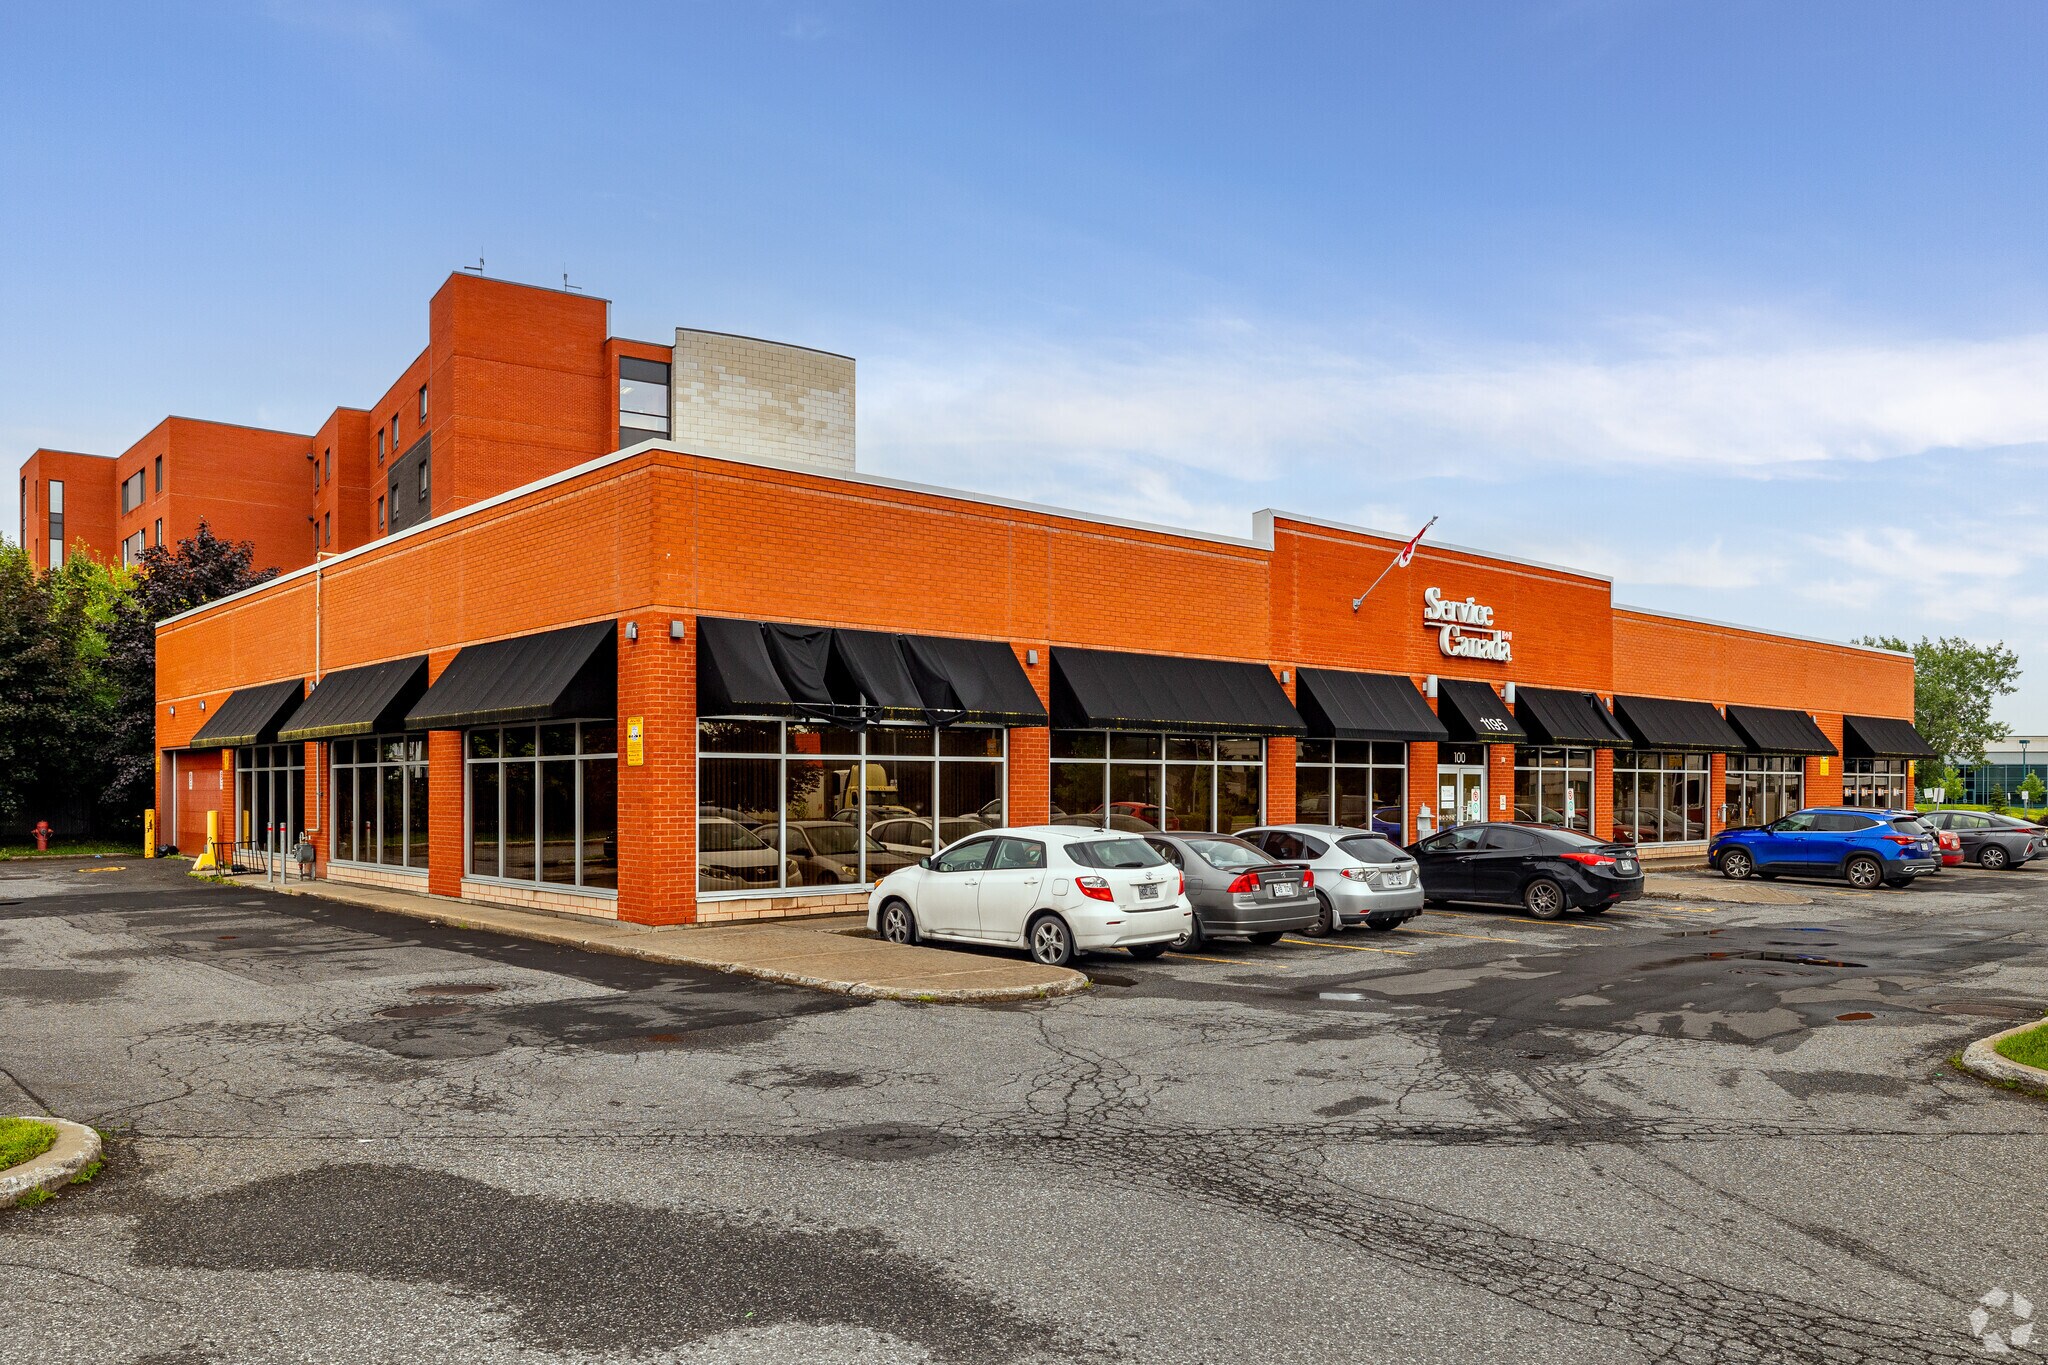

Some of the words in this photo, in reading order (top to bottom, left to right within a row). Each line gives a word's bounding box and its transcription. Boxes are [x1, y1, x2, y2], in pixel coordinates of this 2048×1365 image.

[1424, 587, 1494, 626] Service
[1440, 624, 1513, 661] Canada
[1480, 717, 1508, 731] 1195
[1454, 751, 1466, 763] 100
